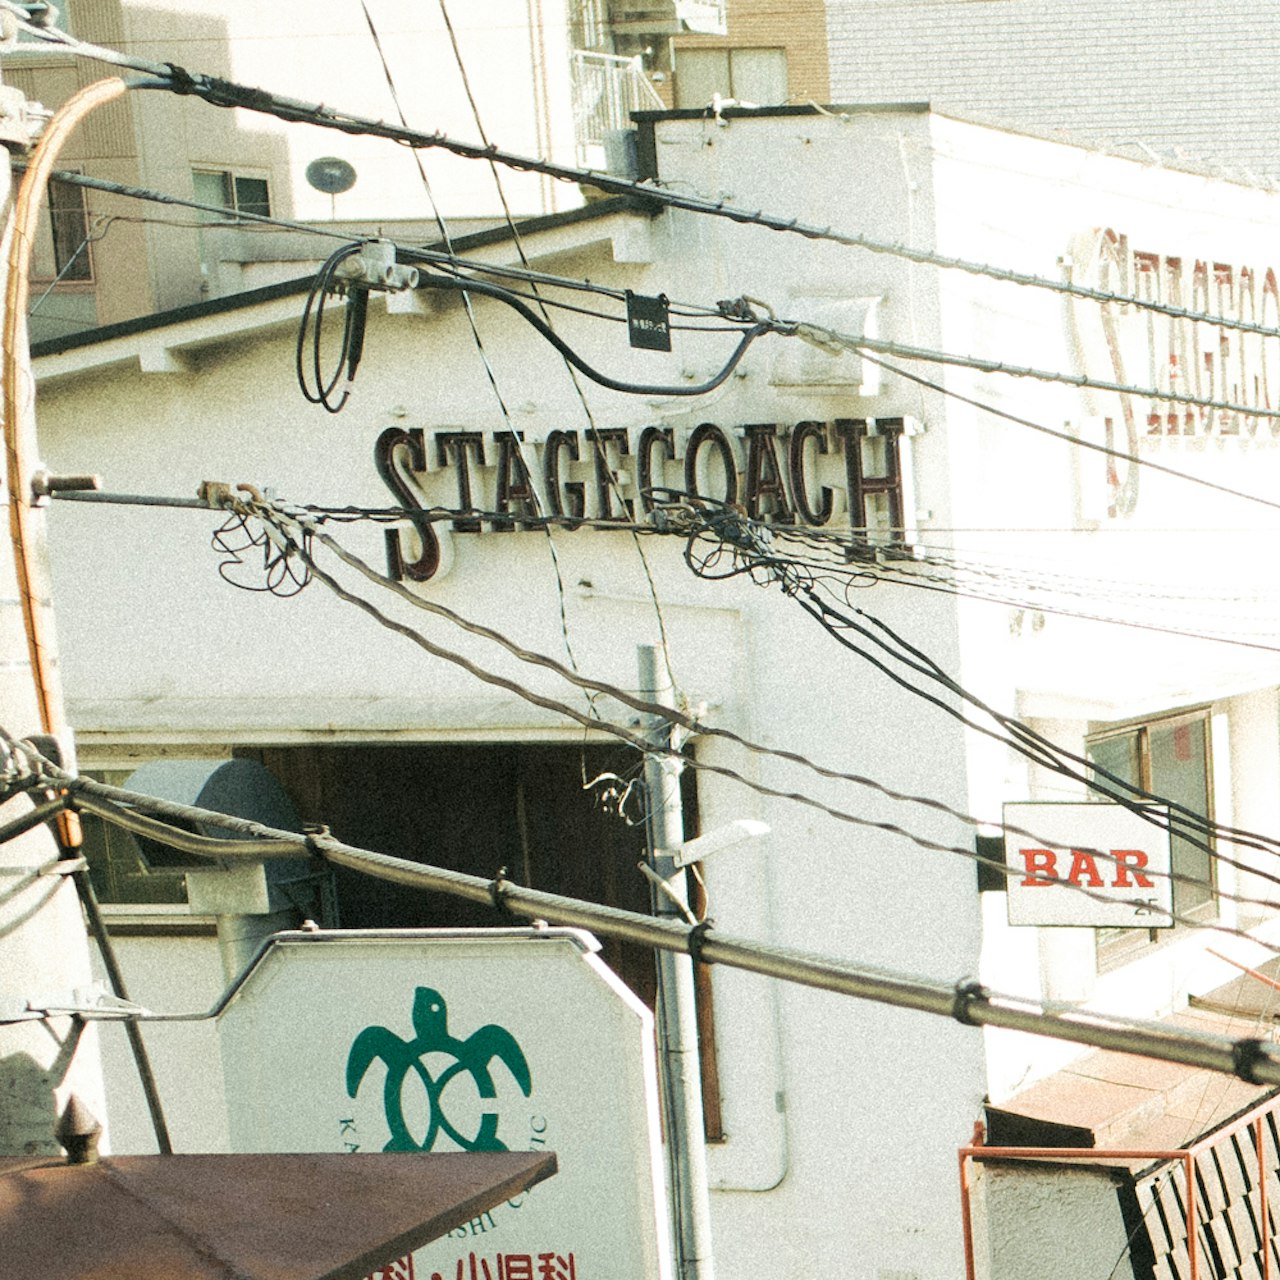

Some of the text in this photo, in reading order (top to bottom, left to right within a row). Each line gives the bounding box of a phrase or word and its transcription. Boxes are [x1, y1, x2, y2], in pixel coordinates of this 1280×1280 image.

[374, 417, 905, 582] STAGECOACH
[1019, 849, 1155, 888] BAR
[1134, 898, 1159, 916] 2F
